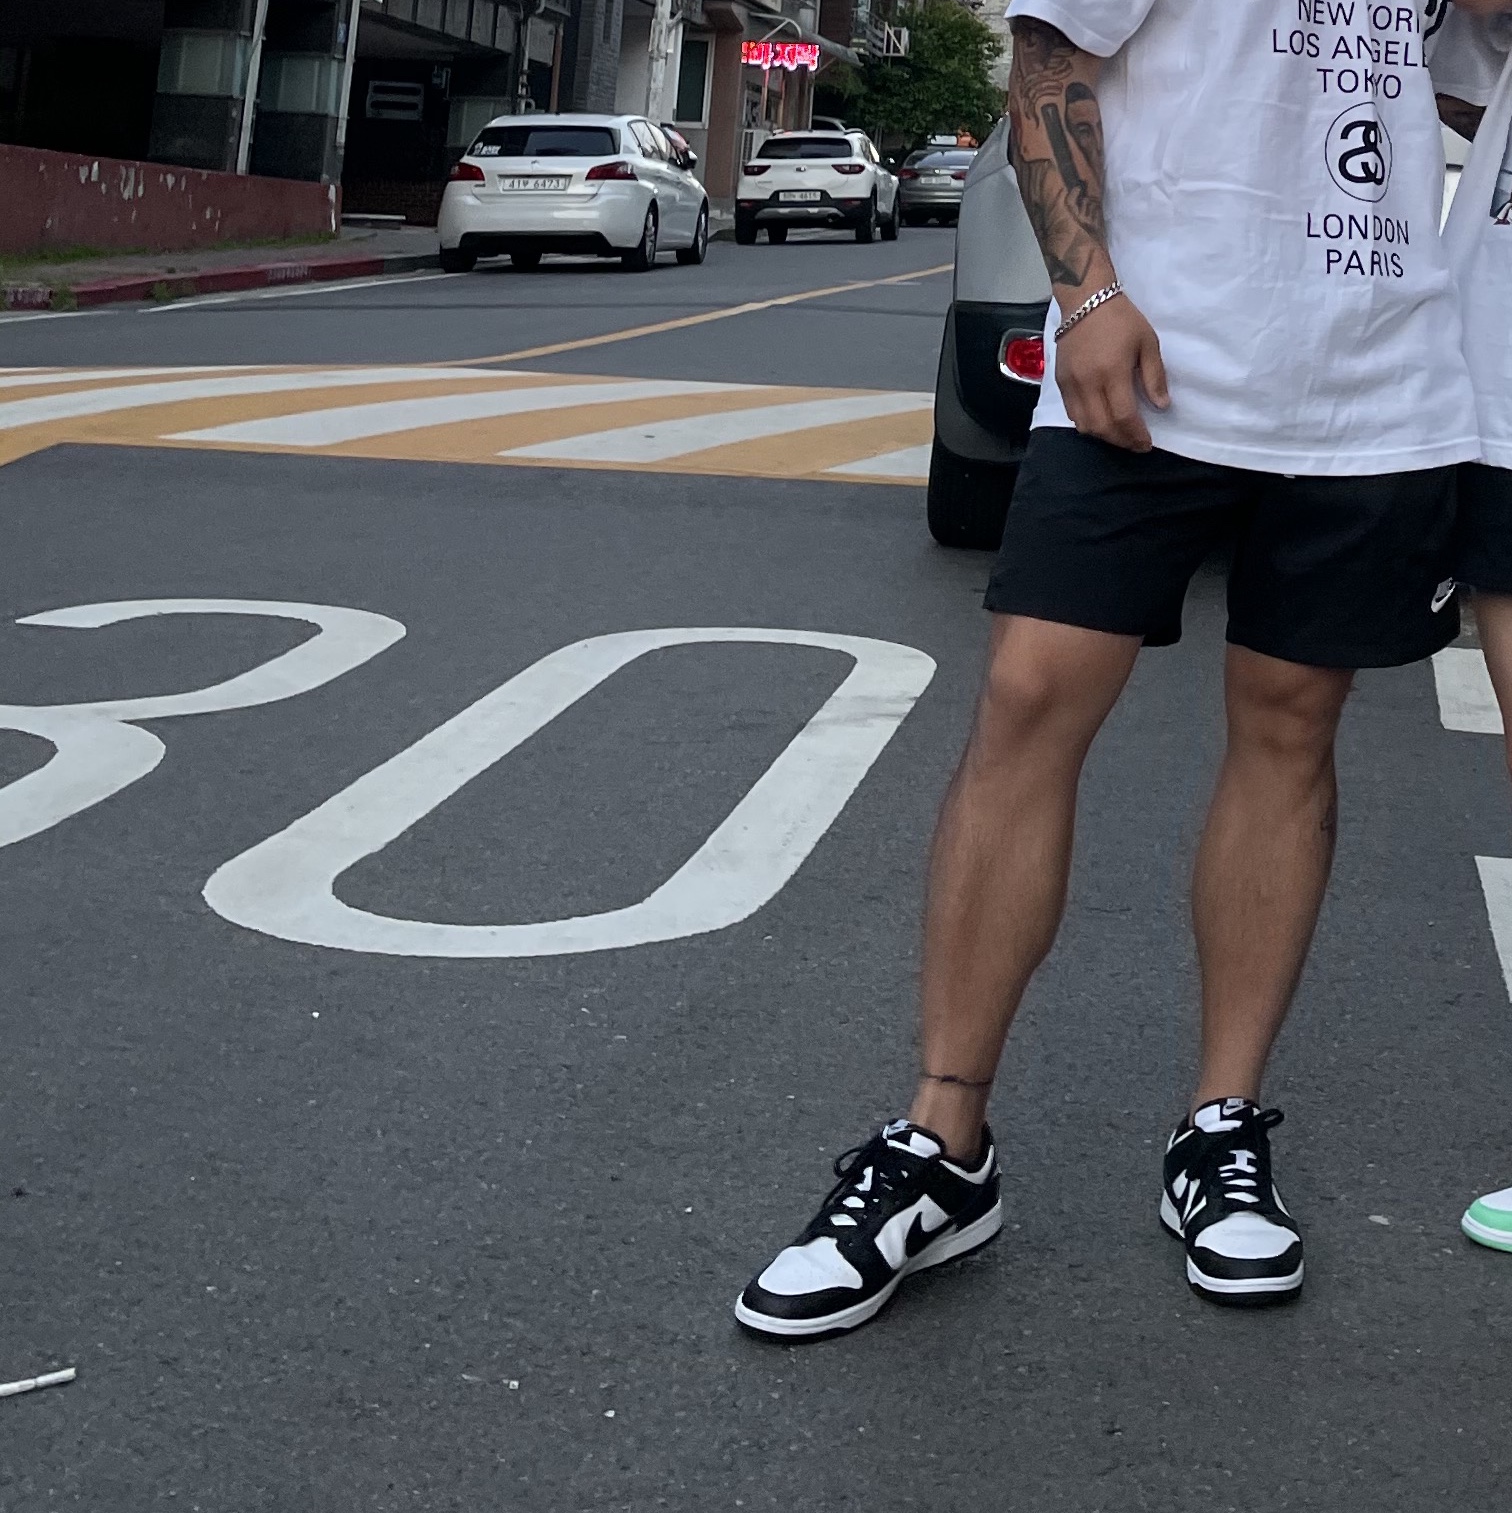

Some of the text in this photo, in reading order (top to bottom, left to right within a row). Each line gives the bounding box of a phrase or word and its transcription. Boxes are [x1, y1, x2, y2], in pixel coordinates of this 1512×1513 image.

[1367, 3, 1420, 34] OR
[1272, 28, 1429, 68] LOS ANGEL
[1316, 68, 1402, 99] TOKYO
[1307, 212, 1409, 245] LONDON
[1326, 249, 1404, 278] PARIS
[0, 598, 938, 958] 30
